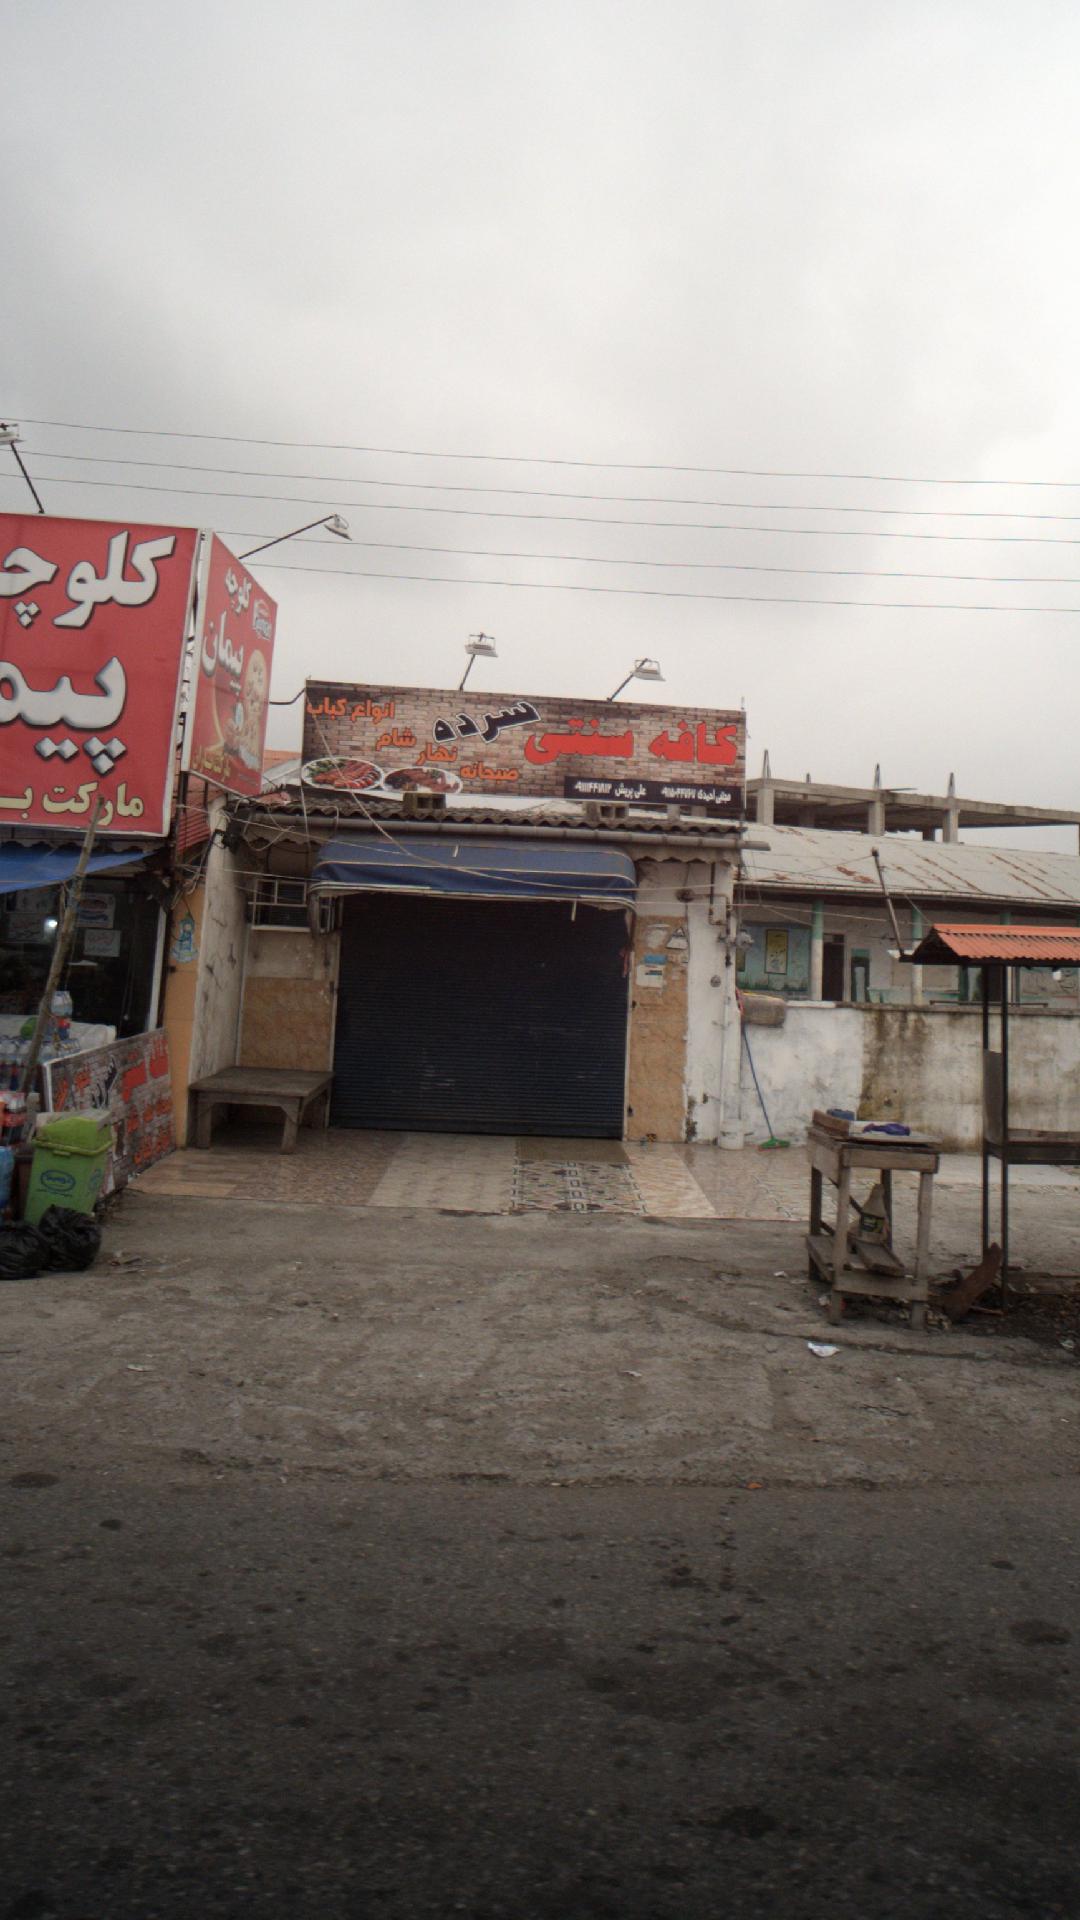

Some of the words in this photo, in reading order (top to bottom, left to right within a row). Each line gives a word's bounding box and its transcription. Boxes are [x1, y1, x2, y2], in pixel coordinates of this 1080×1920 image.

[0, 530, 176, 628] کلوچ
[201, 610, 245, 696] پیمان
[0, 656, 128, 775] پیم
[306, 696, 347, 717] کباب
[351, 700, 395, 725] انواع
[375, 726, 417, 751] شام
[416, 742, 458, 766] نهار
[524, 718, 635, 766] سنتی
[648, 719, 738, 766] کافه
[459, 760, 520, 782] صبحانه
[42, 782, 145, 826] مارکت
